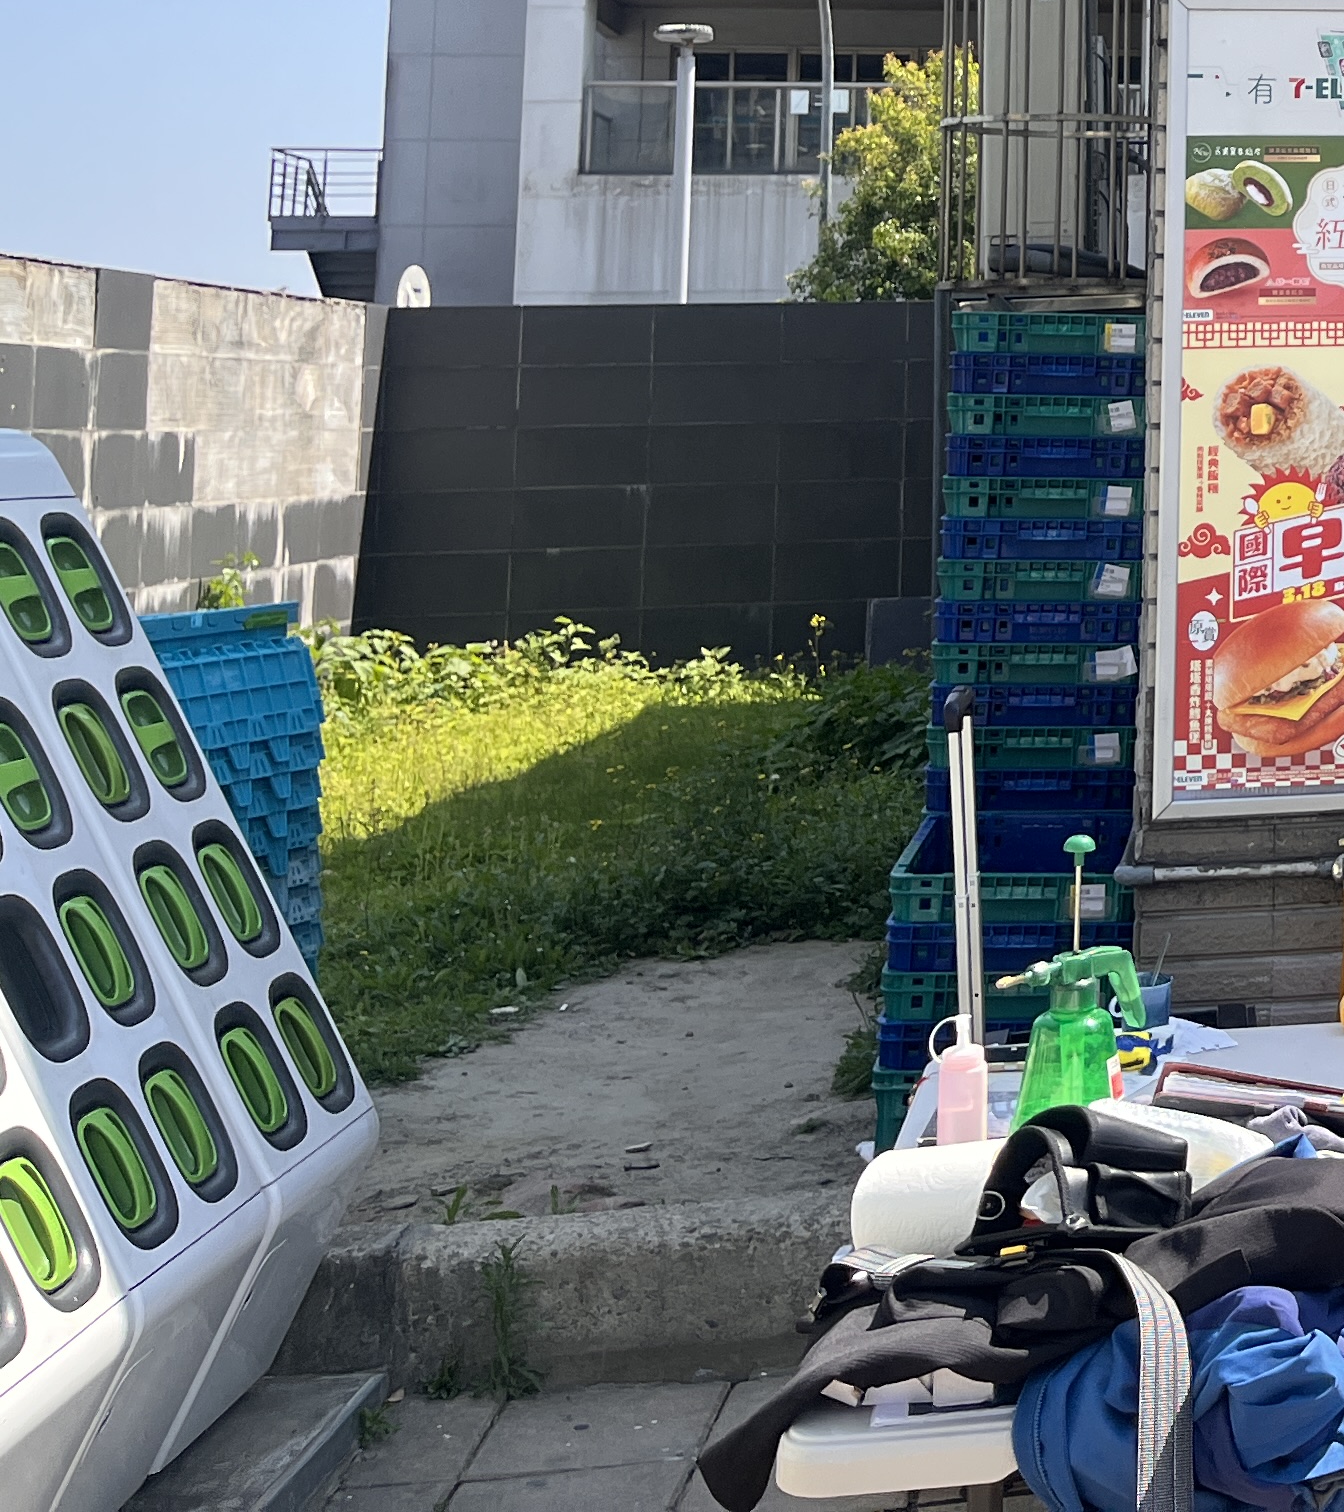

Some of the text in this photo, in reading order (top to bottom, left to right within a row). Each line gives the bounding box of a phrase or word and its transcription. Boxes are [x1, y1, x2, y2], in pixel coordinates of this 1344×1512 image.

[1247, 73, 1277, 105] 有
[1238, 531, 1268, 595] 國際
[1282, 580, 1326, 605] 3.18
